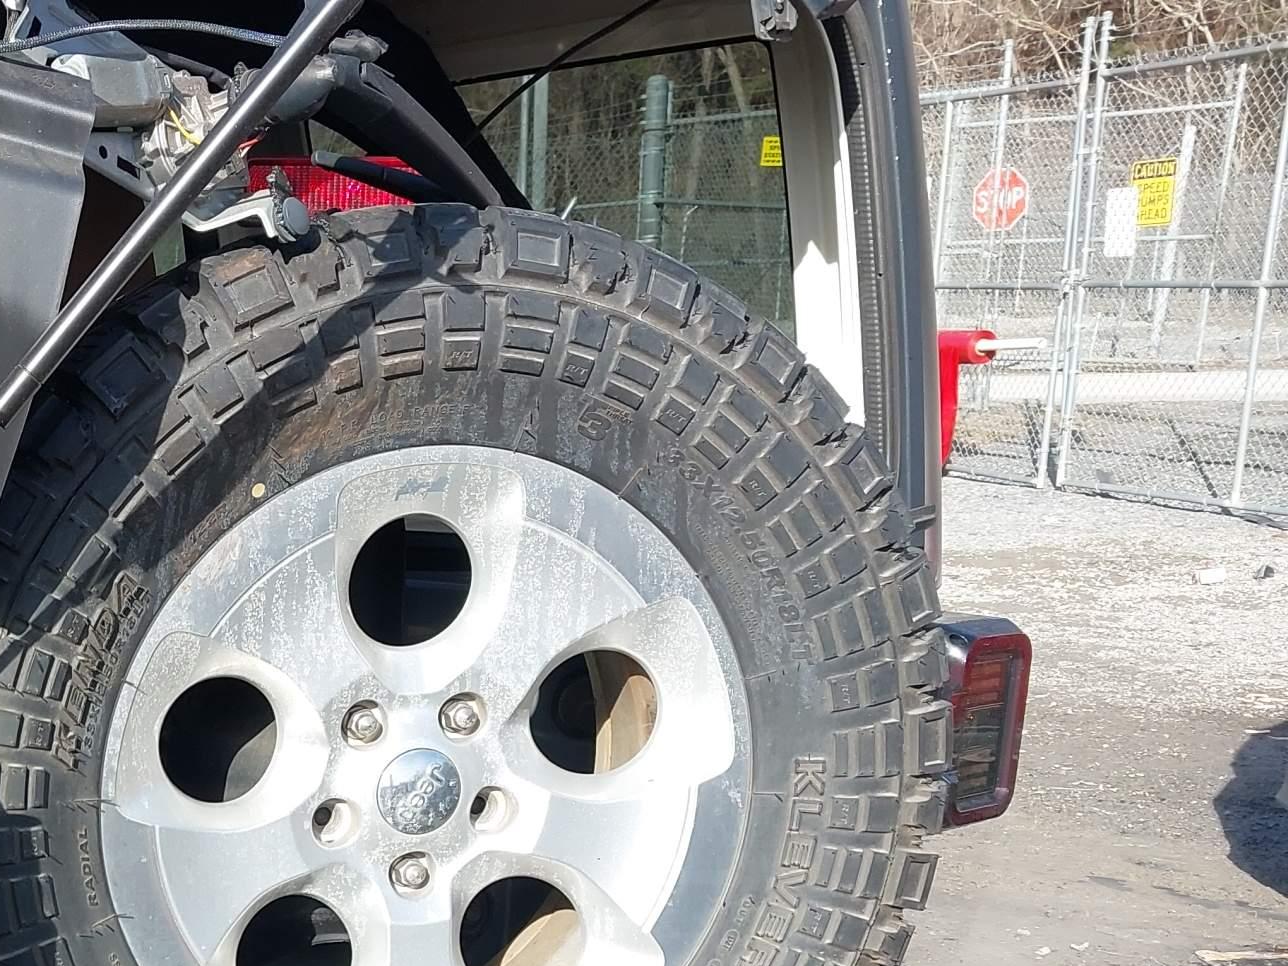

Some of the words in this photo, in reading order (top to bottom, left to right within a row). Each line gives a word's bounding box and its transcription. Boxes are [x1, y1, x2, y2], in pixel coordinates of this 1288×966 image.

[566, 362, 588, 377] R/T
[411, 403, 456, 418] RANGE
[665, 407, 686, 425] R/T
[747, 478, 767, 499] R/T
[399, 763, 445, 822] Jeep
[75, 827, 101, 907] RADIAL
